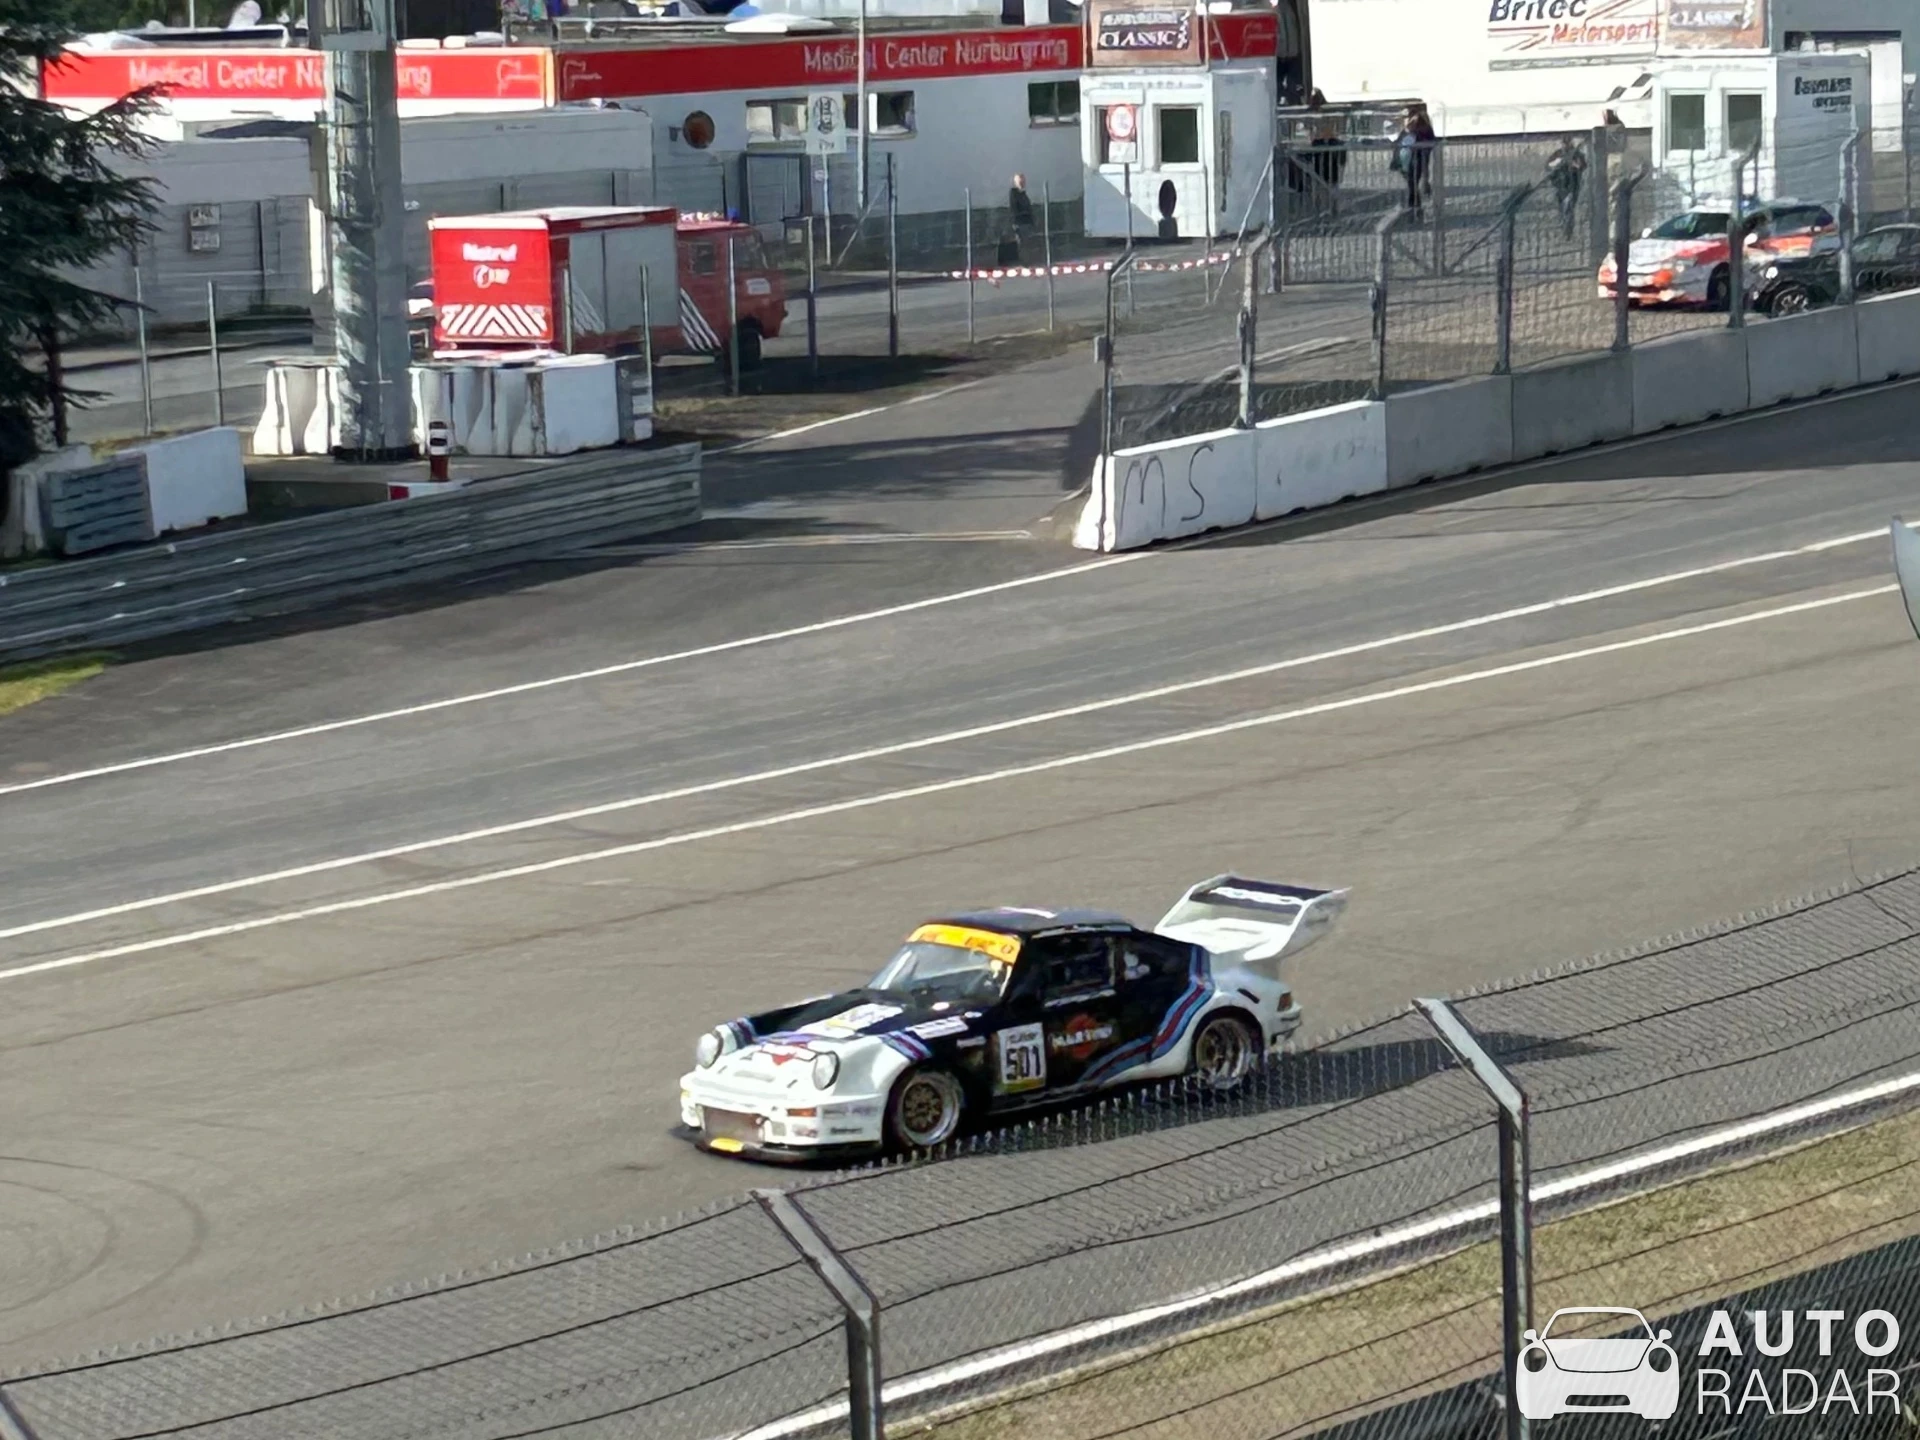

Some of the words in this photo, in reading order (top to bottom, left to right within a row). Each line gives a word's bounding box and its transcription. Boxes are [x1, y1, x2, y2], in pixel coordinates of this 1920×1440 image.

[884, 40, 948, 69] Center
[216, 60, 287, 89] Center
[1006, 1045, 1041, 1080] 501
